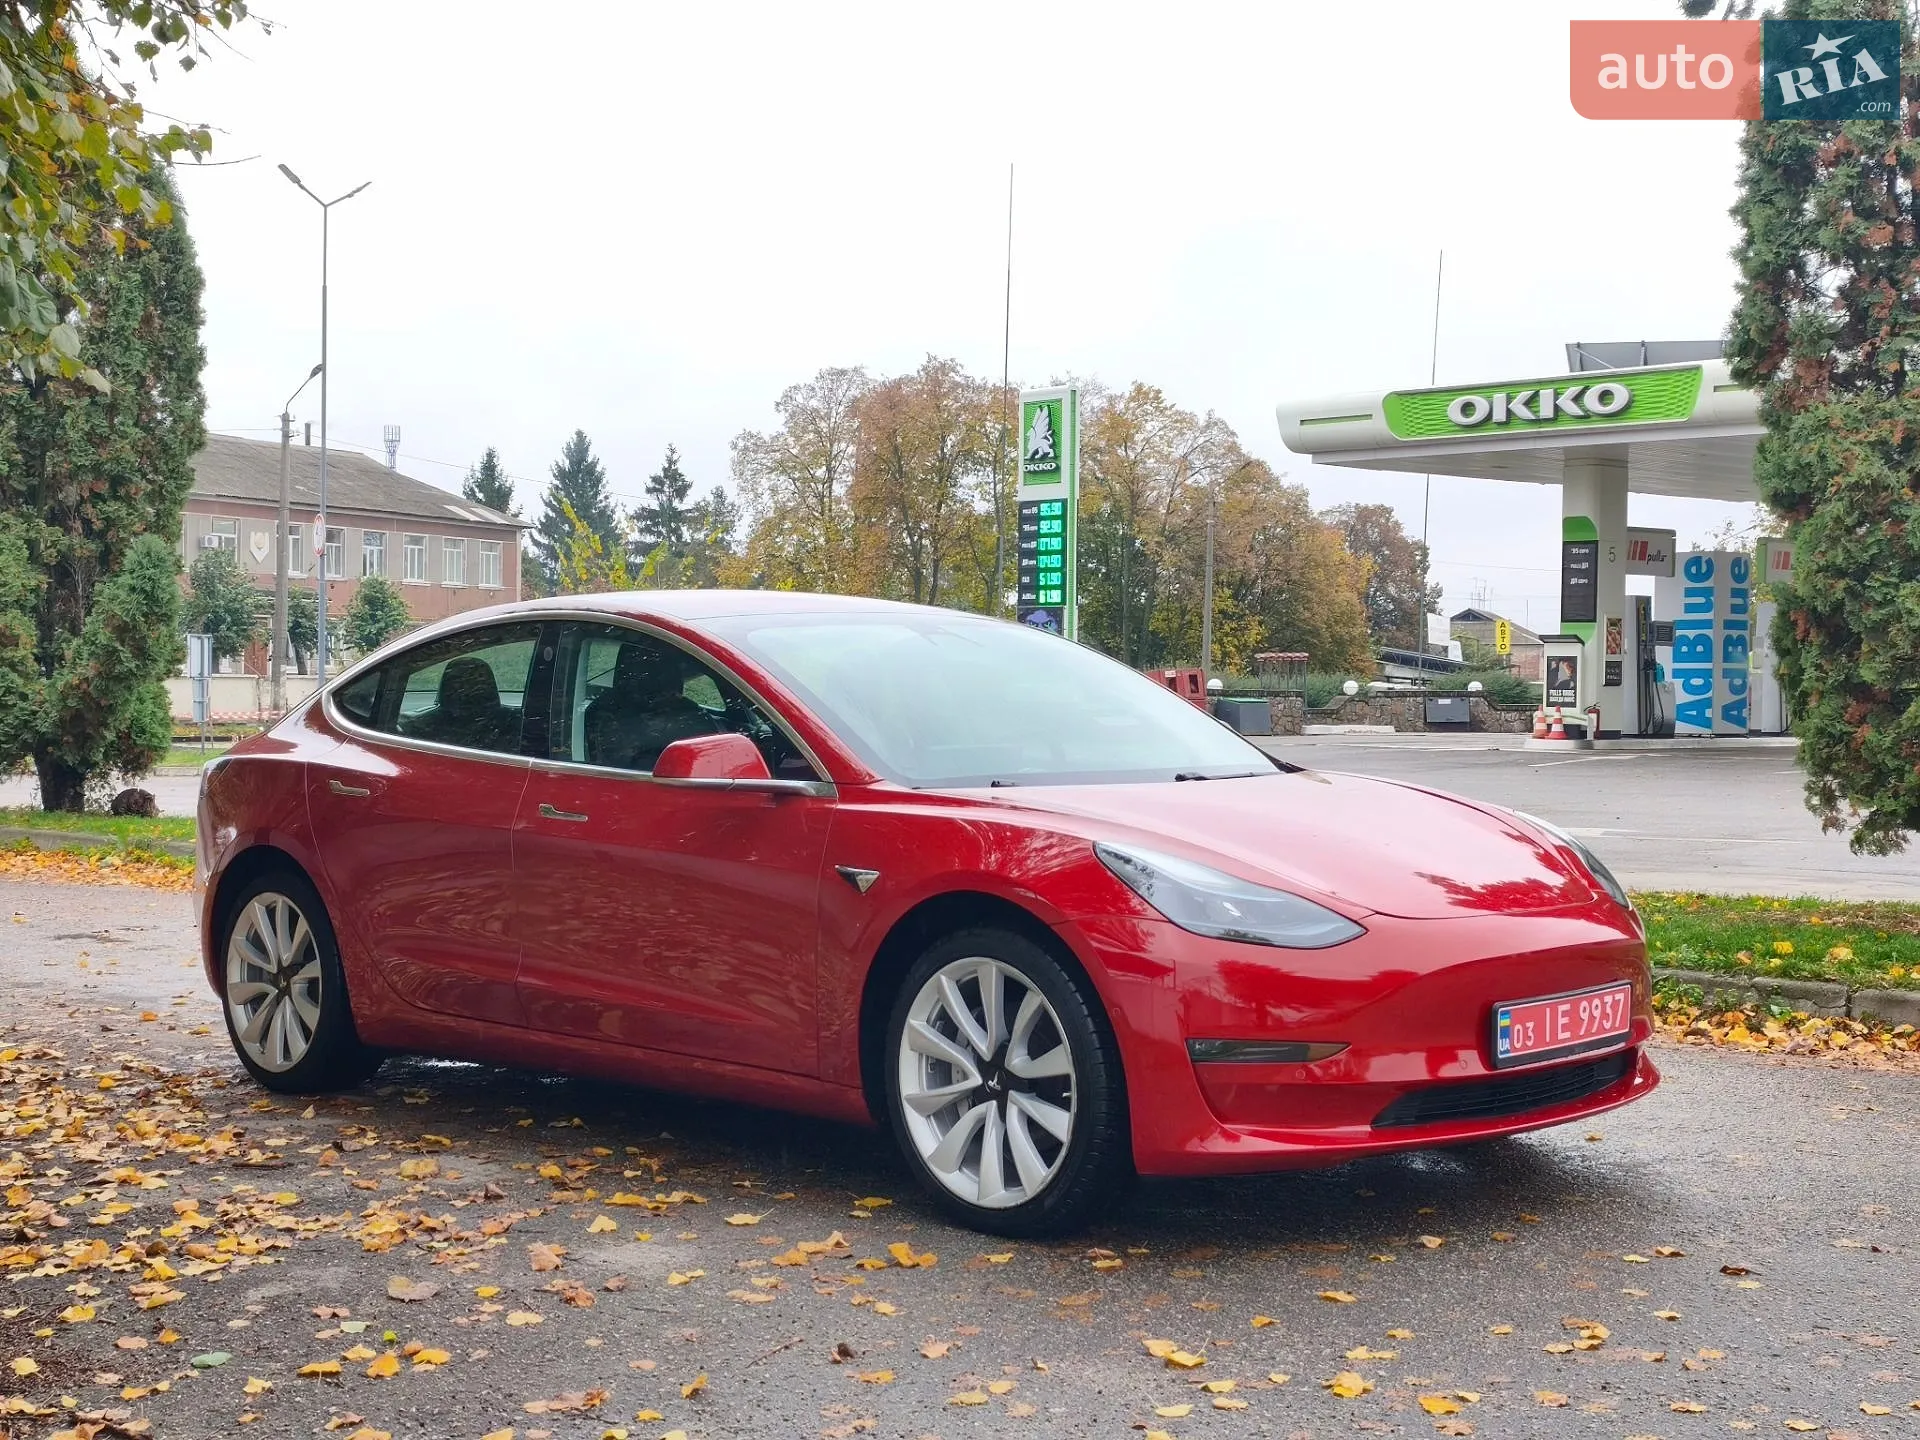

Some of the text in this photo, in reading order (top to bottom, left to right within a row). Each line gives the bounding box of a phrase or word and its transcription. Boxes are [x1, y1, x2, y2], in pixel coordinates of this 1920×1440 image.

[1447, 382, 1630, 426] OKKO
[1023, 462, 1057, 472] OKKO
[1608, 546, 1617, 563] 5
[1673, 555, 1715, 730] AdBlue
[1721, 556, 1749, 730] AdBlue
[1513, 992, 1625, 1049] 03 IE 9937
[1499, 1037, 1511, 1052] UA
